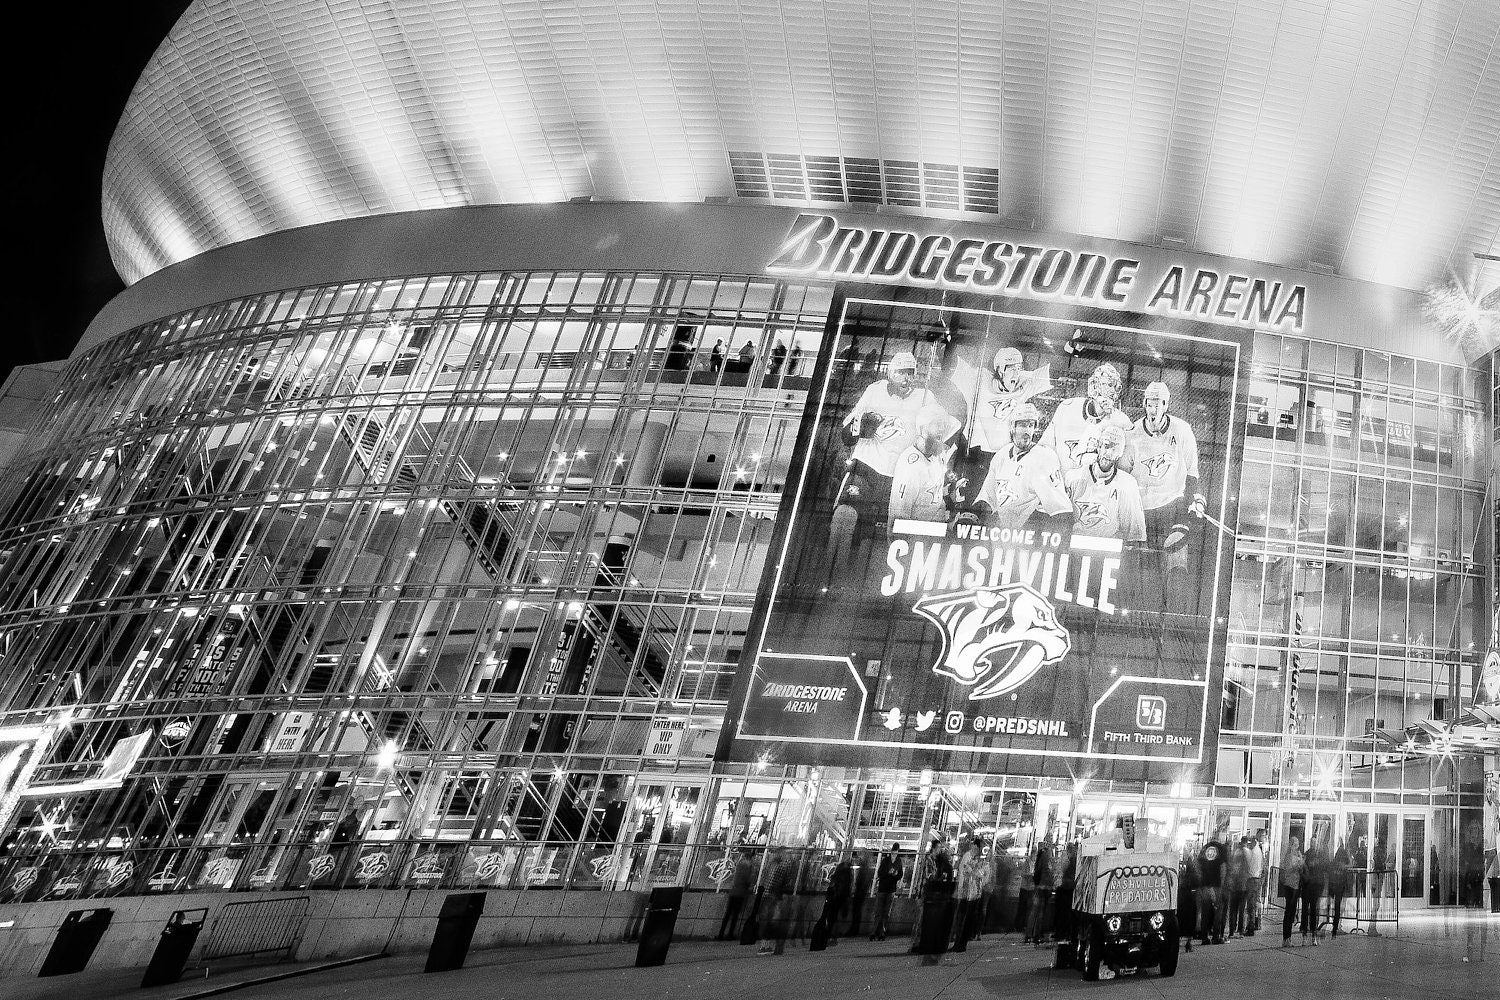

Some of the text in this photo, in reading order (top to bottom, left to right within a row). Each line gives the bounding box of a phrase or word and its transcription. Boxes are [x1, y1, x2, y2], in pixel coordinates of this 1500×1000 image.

[766, 213, 1307, 331] BRIDGESTONE ARENA
[957, 523, 1062, 547] WELCOME TO
[880, 539, 1121, 615] SMASHVILLE
[762, 682, 847, 701] BRIDGESTONE
[783, 700, 818, 714] ARENA
[284, 726, 302, 735] ENTRY
[653, 720, 685, 729] ENTER HERE
[973, 716, 1069, 737] @PREDSNHL
[659, 731, 673, 742] VIP
[1104, 731, 1193, 746] FIFTH THIRD BANK
[276, 738, 297, 750] HERE
[653, 743, 673, 755] ONLY
[1110, 878, 1166, 890] NASHVILLE
[1109, 888, 1167, 904] PREDATORS
